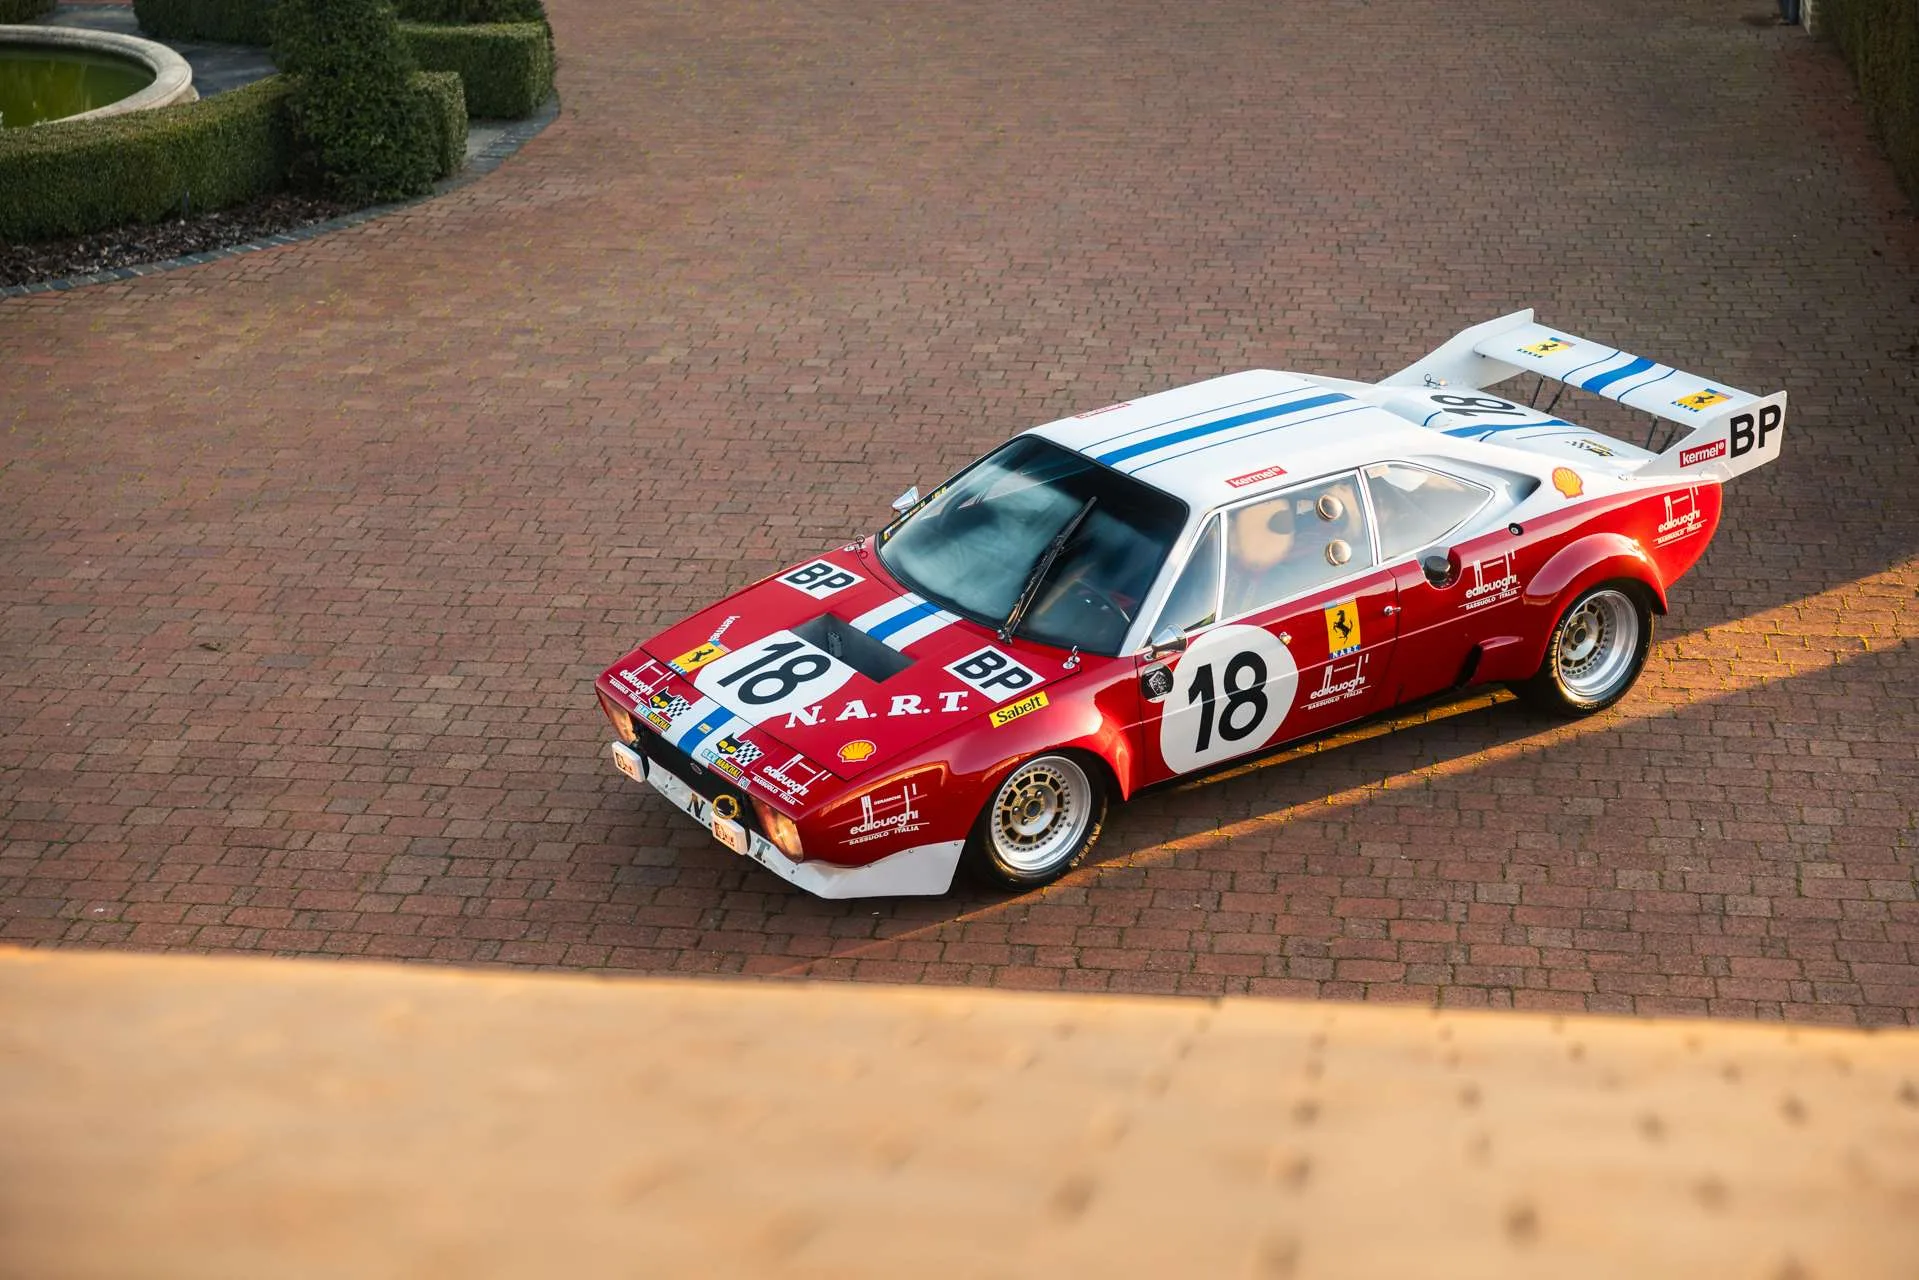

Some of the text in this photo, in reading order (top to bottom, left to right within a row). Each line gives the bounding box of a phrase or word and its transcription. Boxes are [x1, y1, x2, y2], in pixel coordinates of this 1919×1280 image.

[1430, 394, 1527, 416] 18
[1730, 404, 1782, 459] BP
[784, 562, 855, 591] BP
[717, 641, 831, 705] 18
[951, 650, 1034, 690] BP
[998, 696, 1042, 723] Sabelt
[1188, 650, 1269, 754] 18
[894, 825, 920, 834] ITALIA
